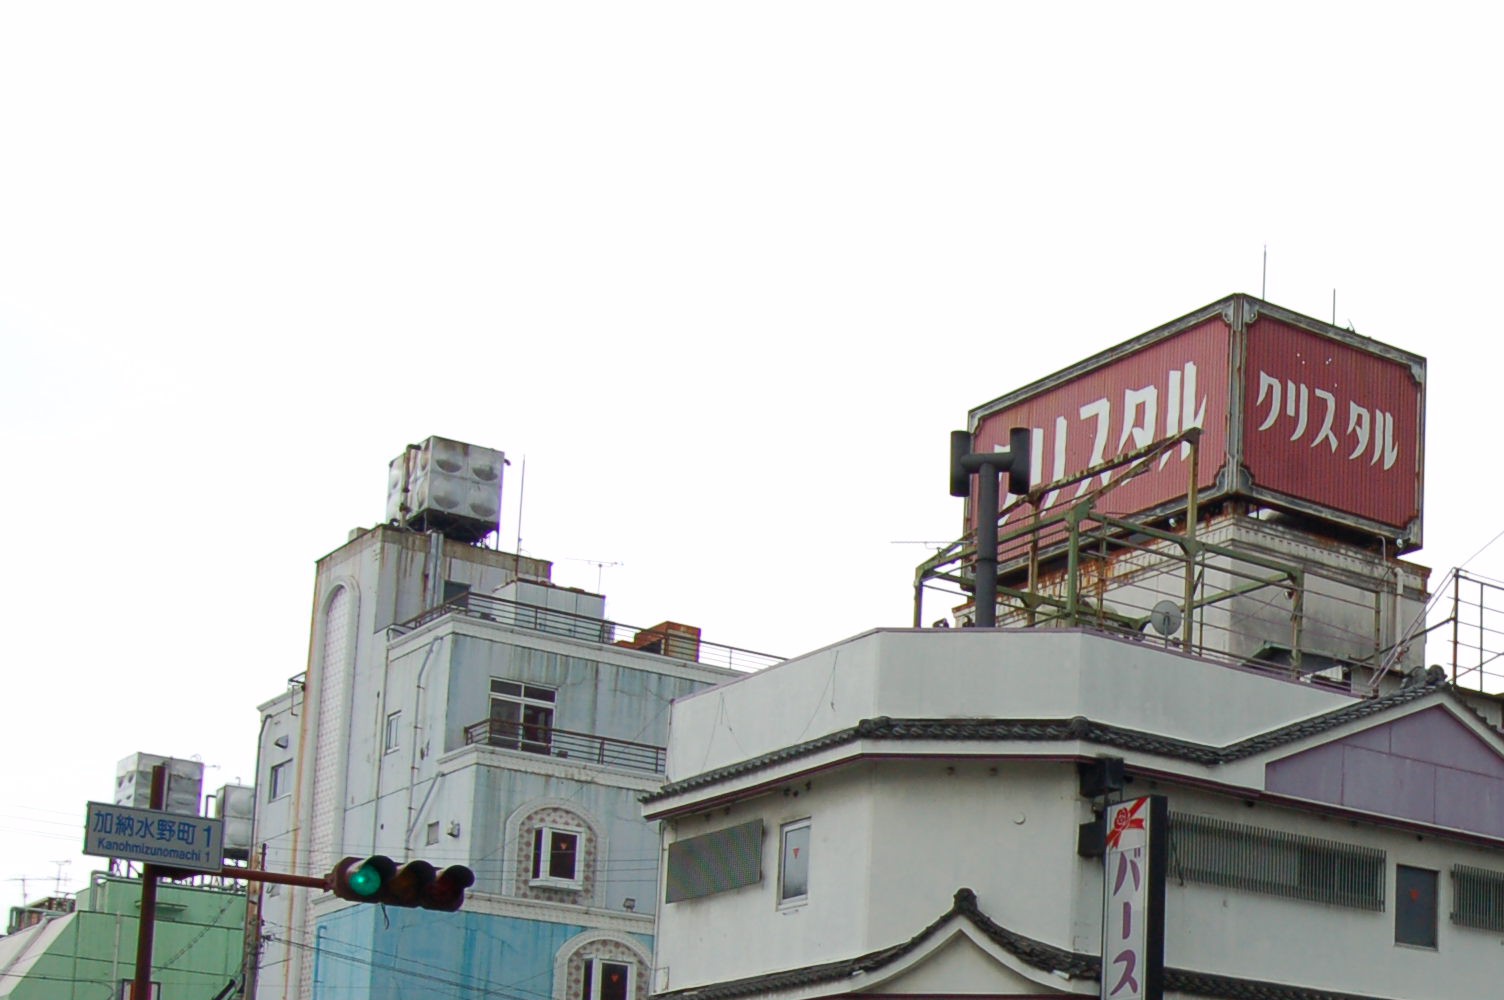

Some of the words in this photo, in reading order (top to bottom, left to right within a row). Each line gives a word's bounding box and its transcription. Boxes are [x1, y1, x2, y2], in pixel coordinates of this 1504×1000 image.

[1256, 370, 1398, 471] クリスタル
[92, 810, 197, 846] 加納水野町
[202, 825, 212, 848] 1
